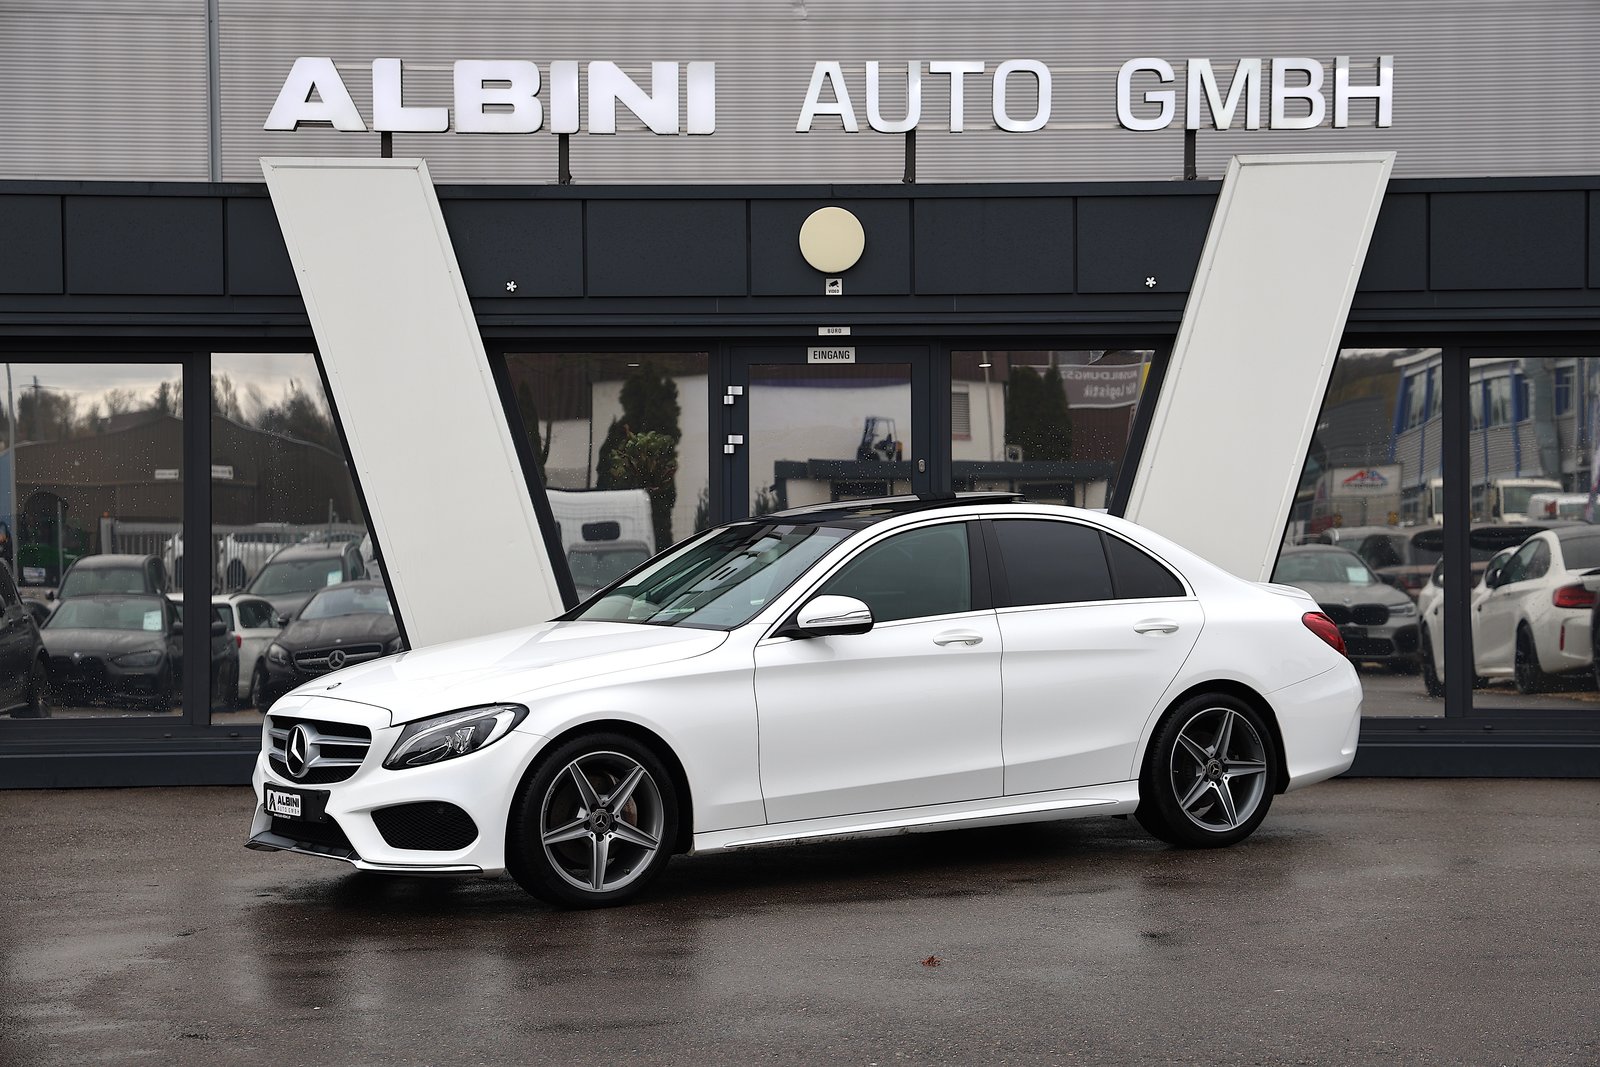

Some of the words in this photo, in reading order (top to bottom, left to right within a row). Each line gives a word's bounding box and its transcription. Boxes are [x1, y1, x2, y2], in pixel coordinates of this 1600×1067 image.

[263, 56, 716, 135] ALBINI
[796, 59, 1052, 134] AUTO
[1116, 55, 1394, 132] GMBH
[813, 350, 850, 360] EINGANG
[278, 795, 299, 807] ALBINI
